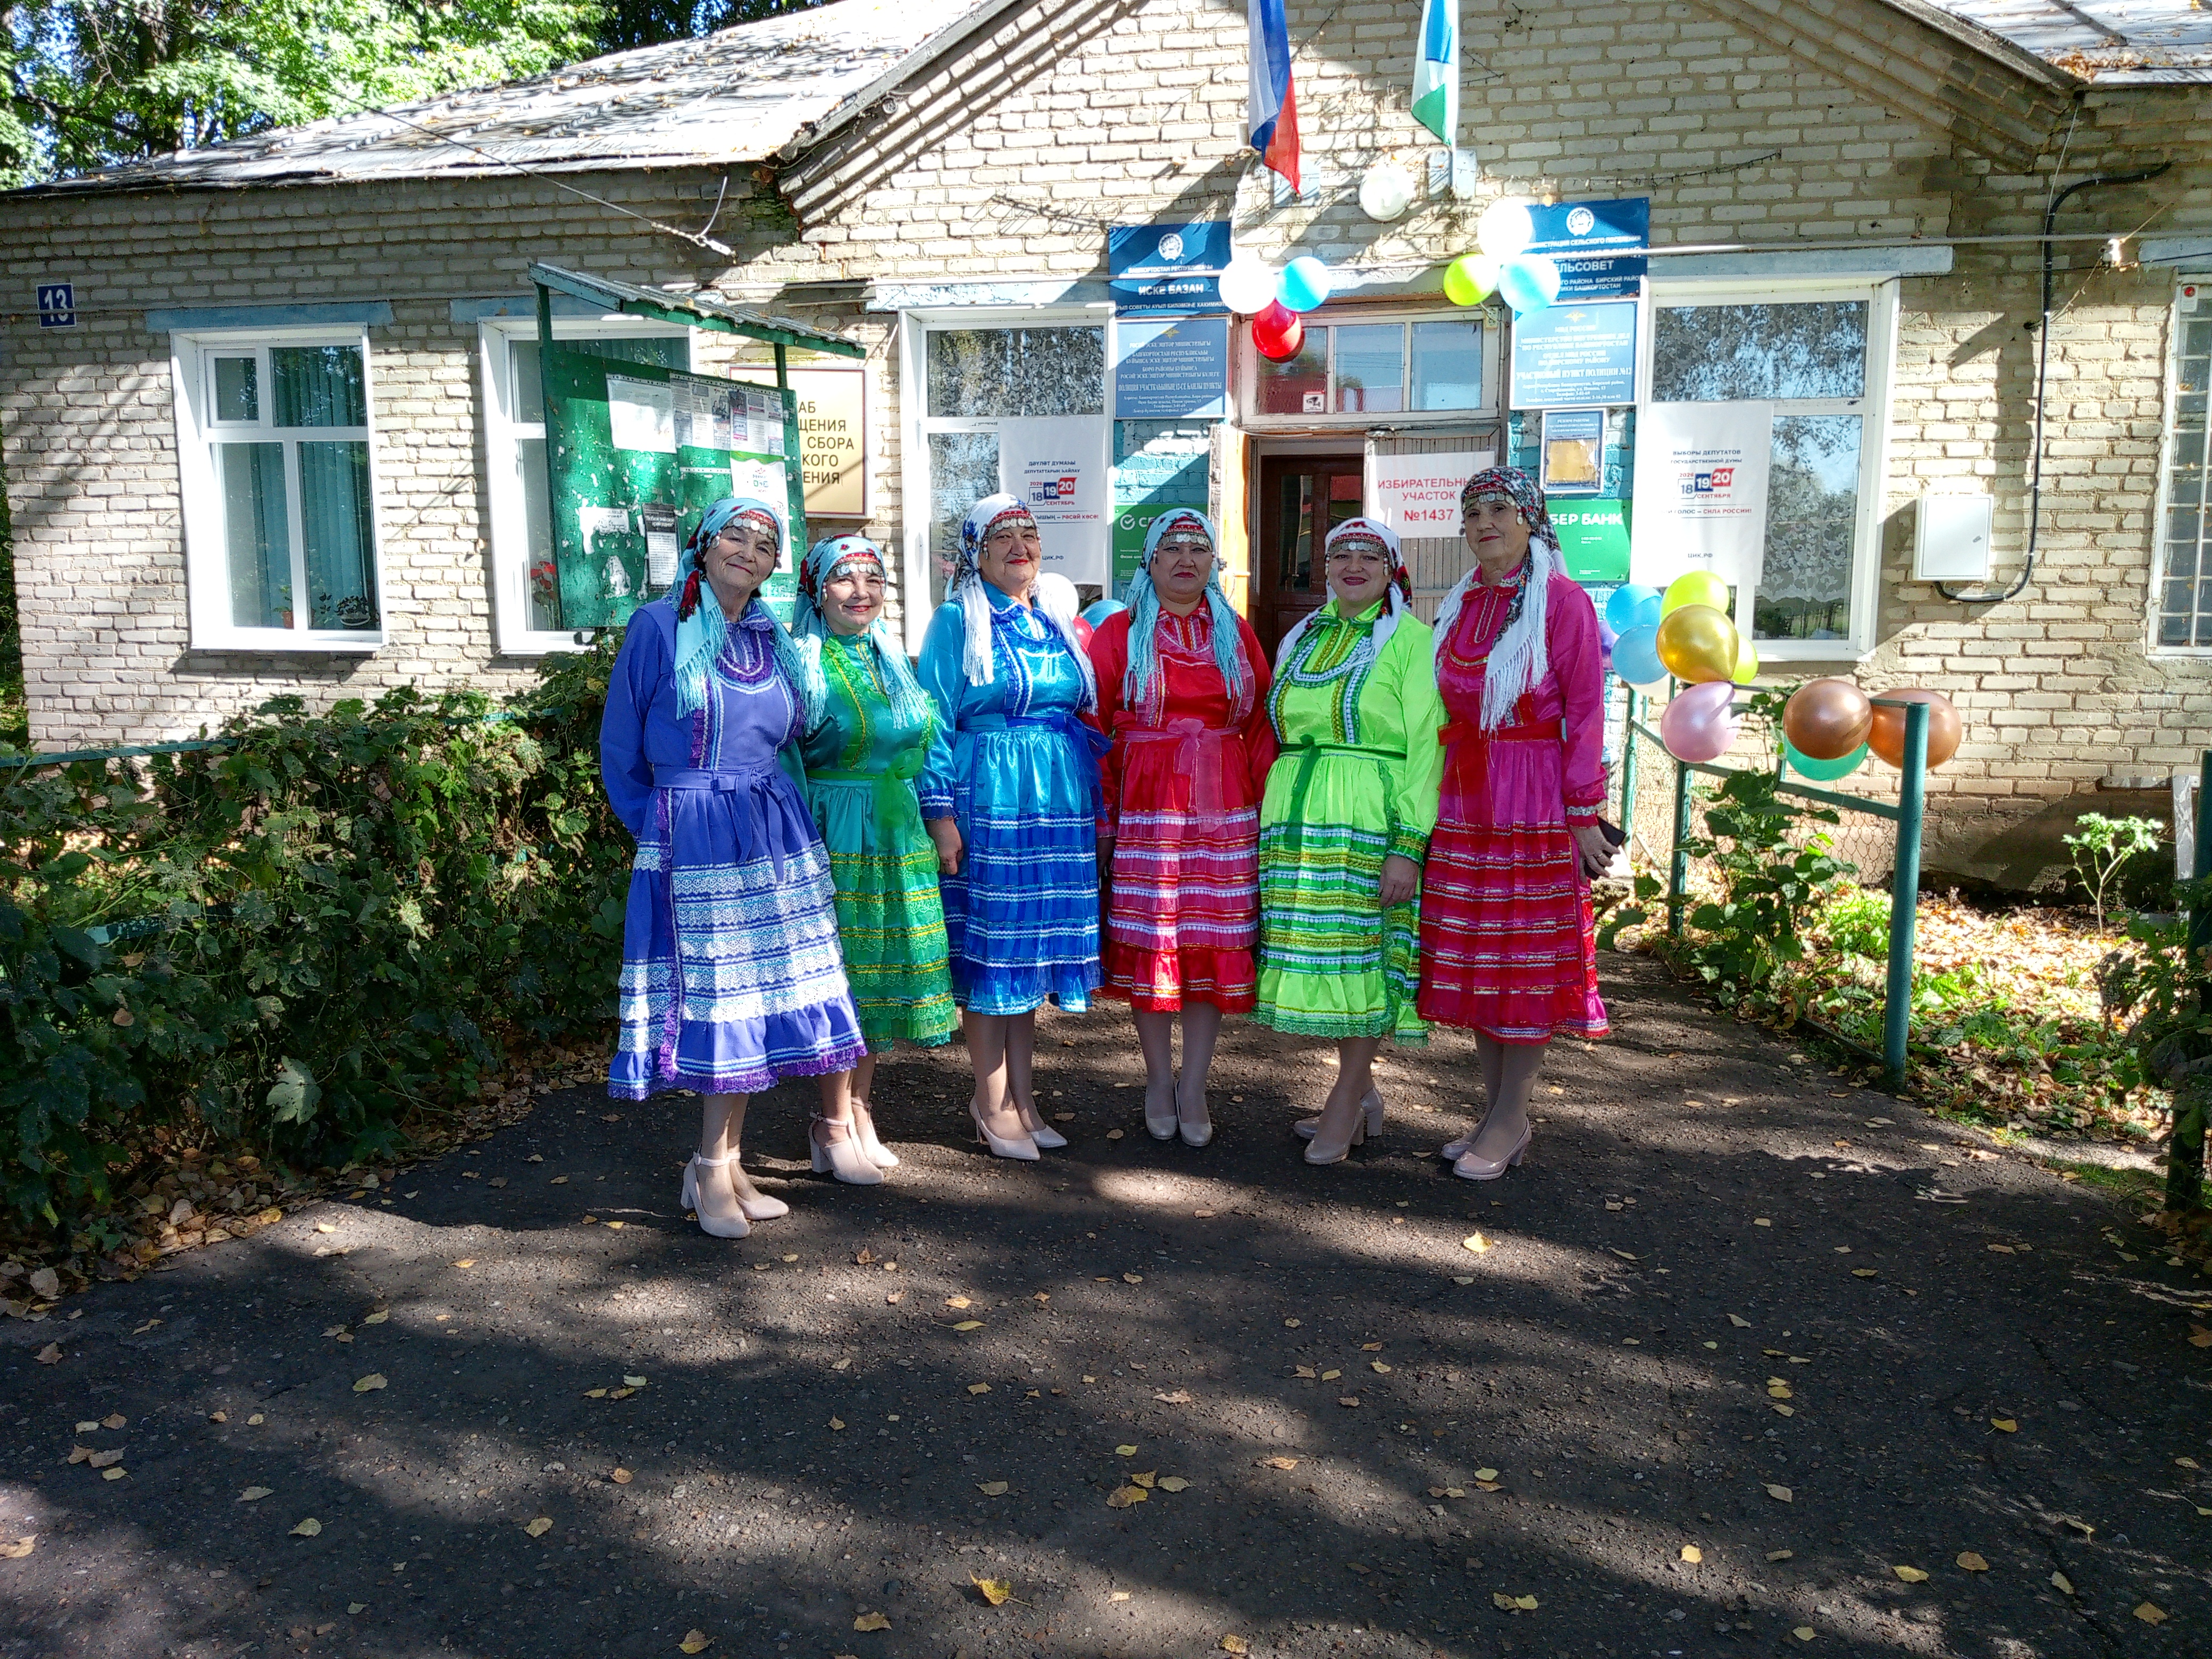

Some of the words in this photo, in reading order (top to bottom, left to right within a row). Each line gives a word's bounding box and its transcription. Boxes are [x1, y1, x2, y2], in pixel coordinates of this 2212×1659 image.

[1570, 237, 1605, 246] СЕЛЬСКОГО
[1574, 283, 1621, 291] БАШКОРТОСТАН
[44, 289, 69, 322] 13
[1562, 369, 1585, 378] ПУНКТ
[1585, 368, 1618, 378] ПОЛИЦИИ
[798, 401, 816, 414] АБ
[807, 436, 854, 450] СБОРА
[802, 454, 839, 467] КОГО
[803, 471, 840, 484] ЕНИЯ
[1681, 484, 1693, 494] 18
[1697, 477, 1710, 489] 19
[1713, 472, 1729, 483] 20
[1032, 492, 1043, 501] 18
[1045, 486, 1057, 497] 19
[1059, 481, 1073, 491] 20
[1402, 491, 1456, 501] УЧАСТОК
[1404, 509, 1454, 522] №1437
[1549, 513, 1579, 525] БЕР
[1581, 513, 1623, 525] БАНК
